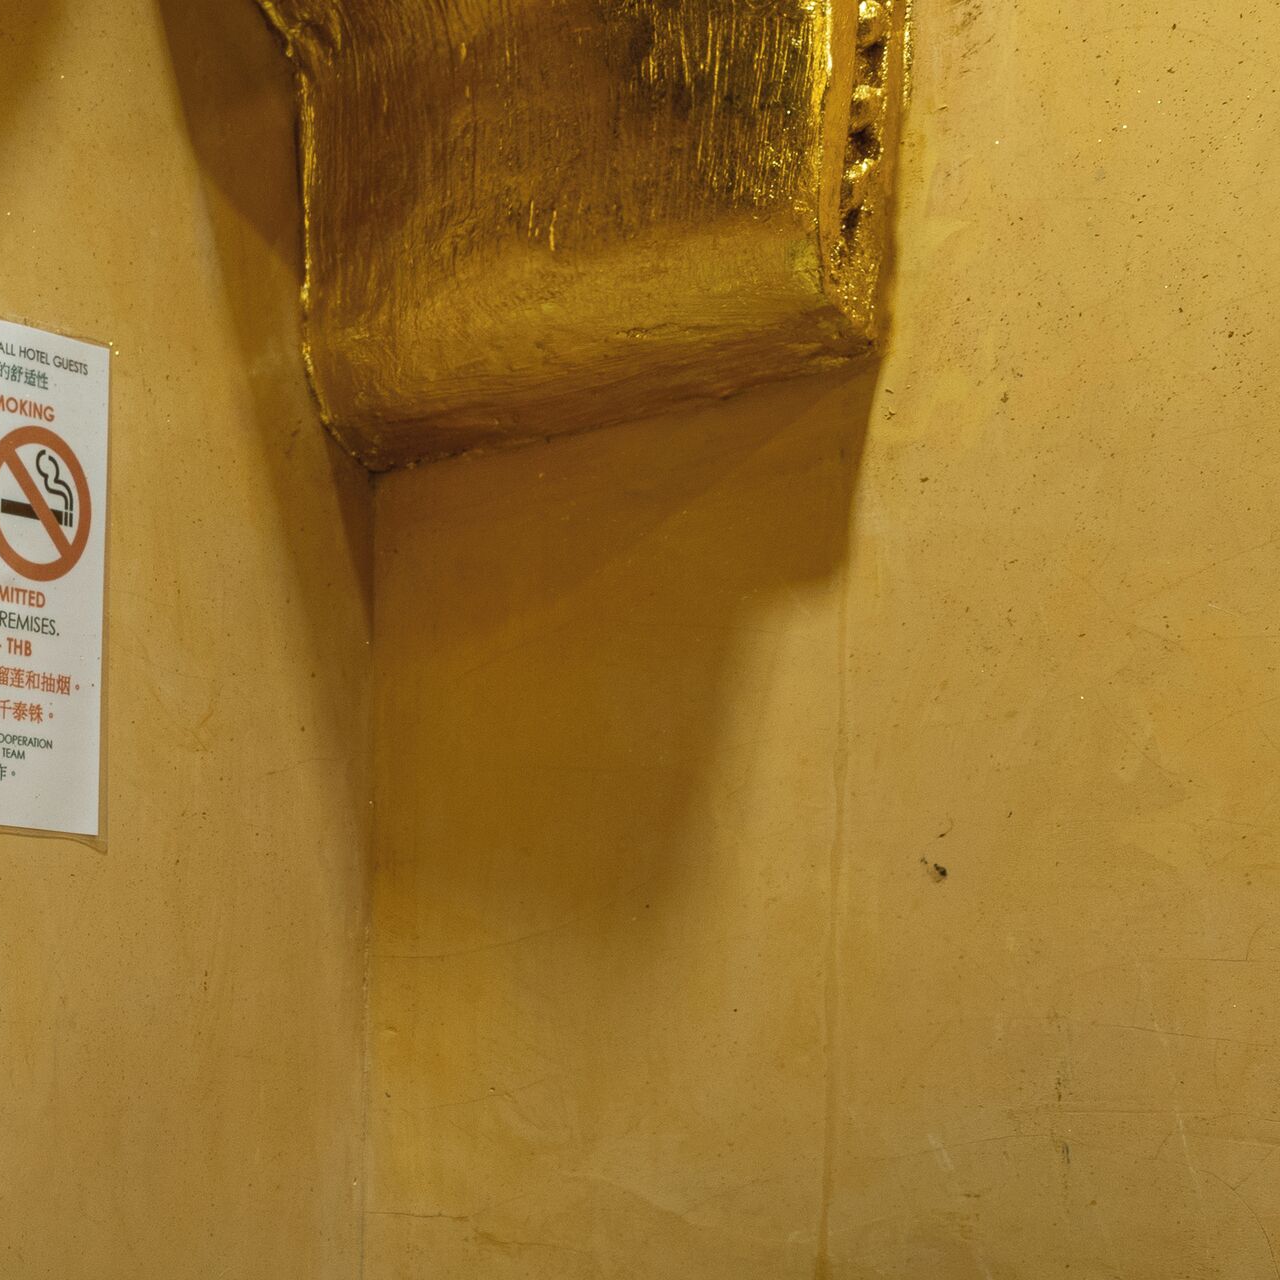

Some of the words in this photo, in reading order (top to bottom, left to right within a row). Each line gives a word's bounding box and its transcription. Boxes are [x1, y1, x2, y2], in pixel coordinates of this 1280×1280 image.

[19, 346, 50, 366] HOTEL
[53, 355, 89, 376] GUESTS
[7, 637, 32, 657] THB
[2, 747, 26, 760] TEAM
